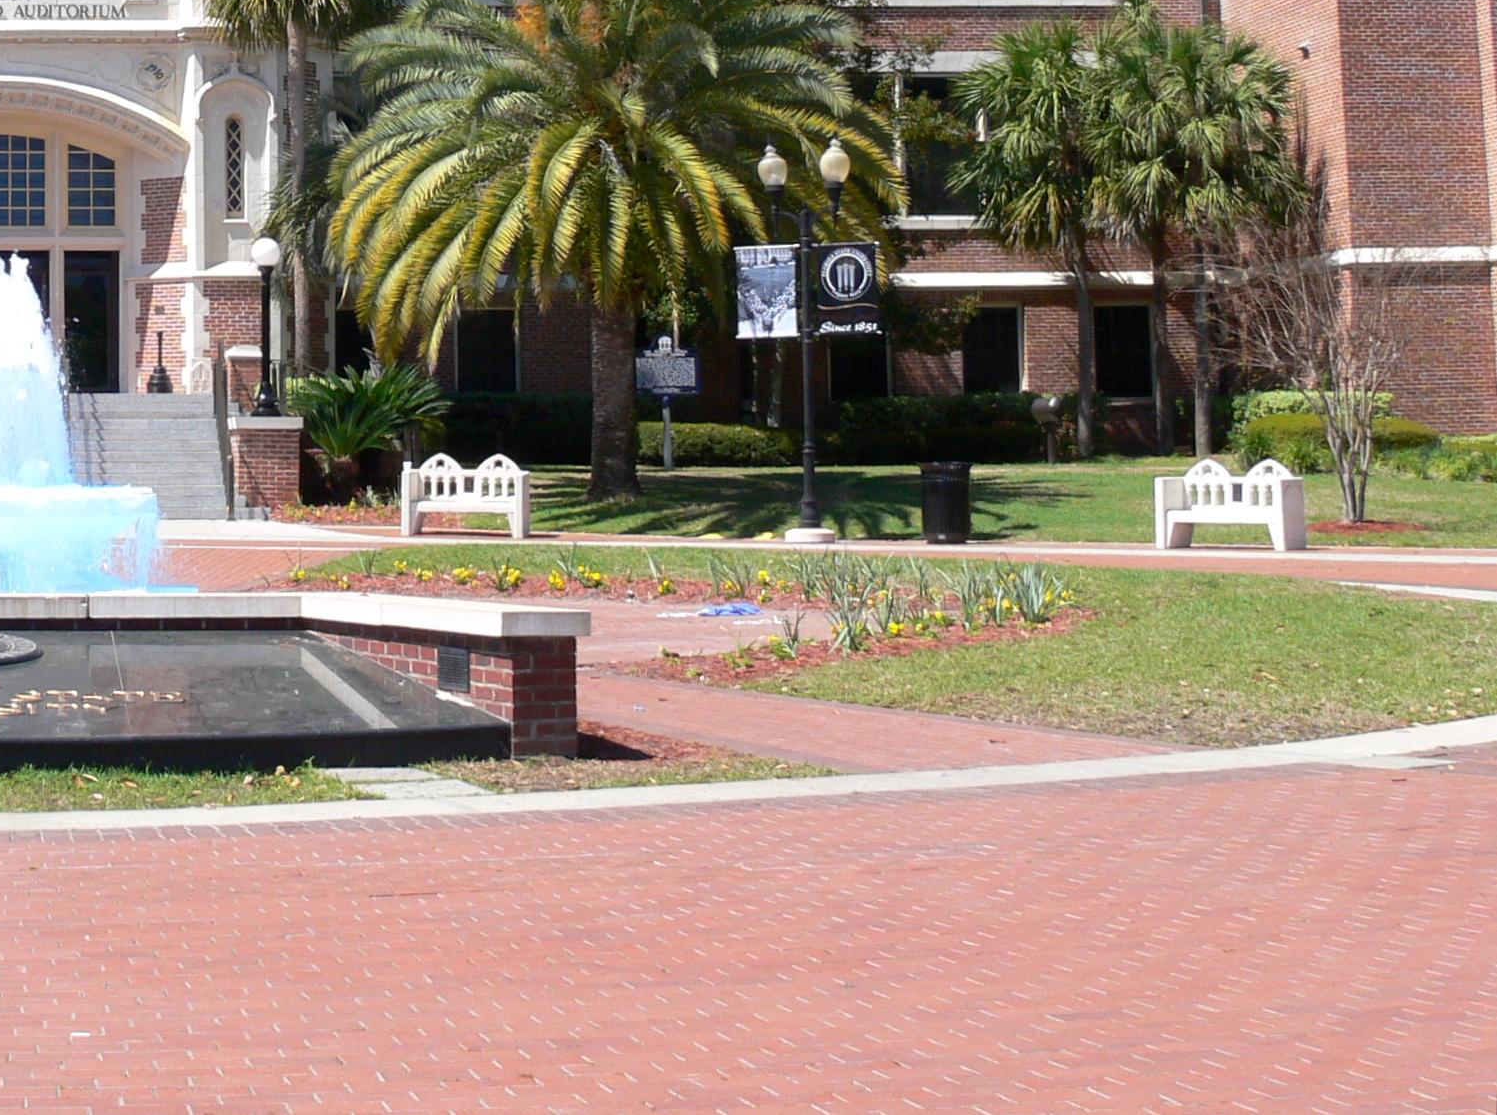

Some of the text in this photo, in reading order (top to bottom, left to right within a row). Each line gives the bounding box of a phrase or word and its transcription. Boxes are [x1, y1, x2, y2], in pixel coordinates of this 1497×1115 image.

[14, 4, 126, 20] AUDITORIUM
[819, 321, 878, 333] Since 1851
[10, 689, 186, 703] STATE
